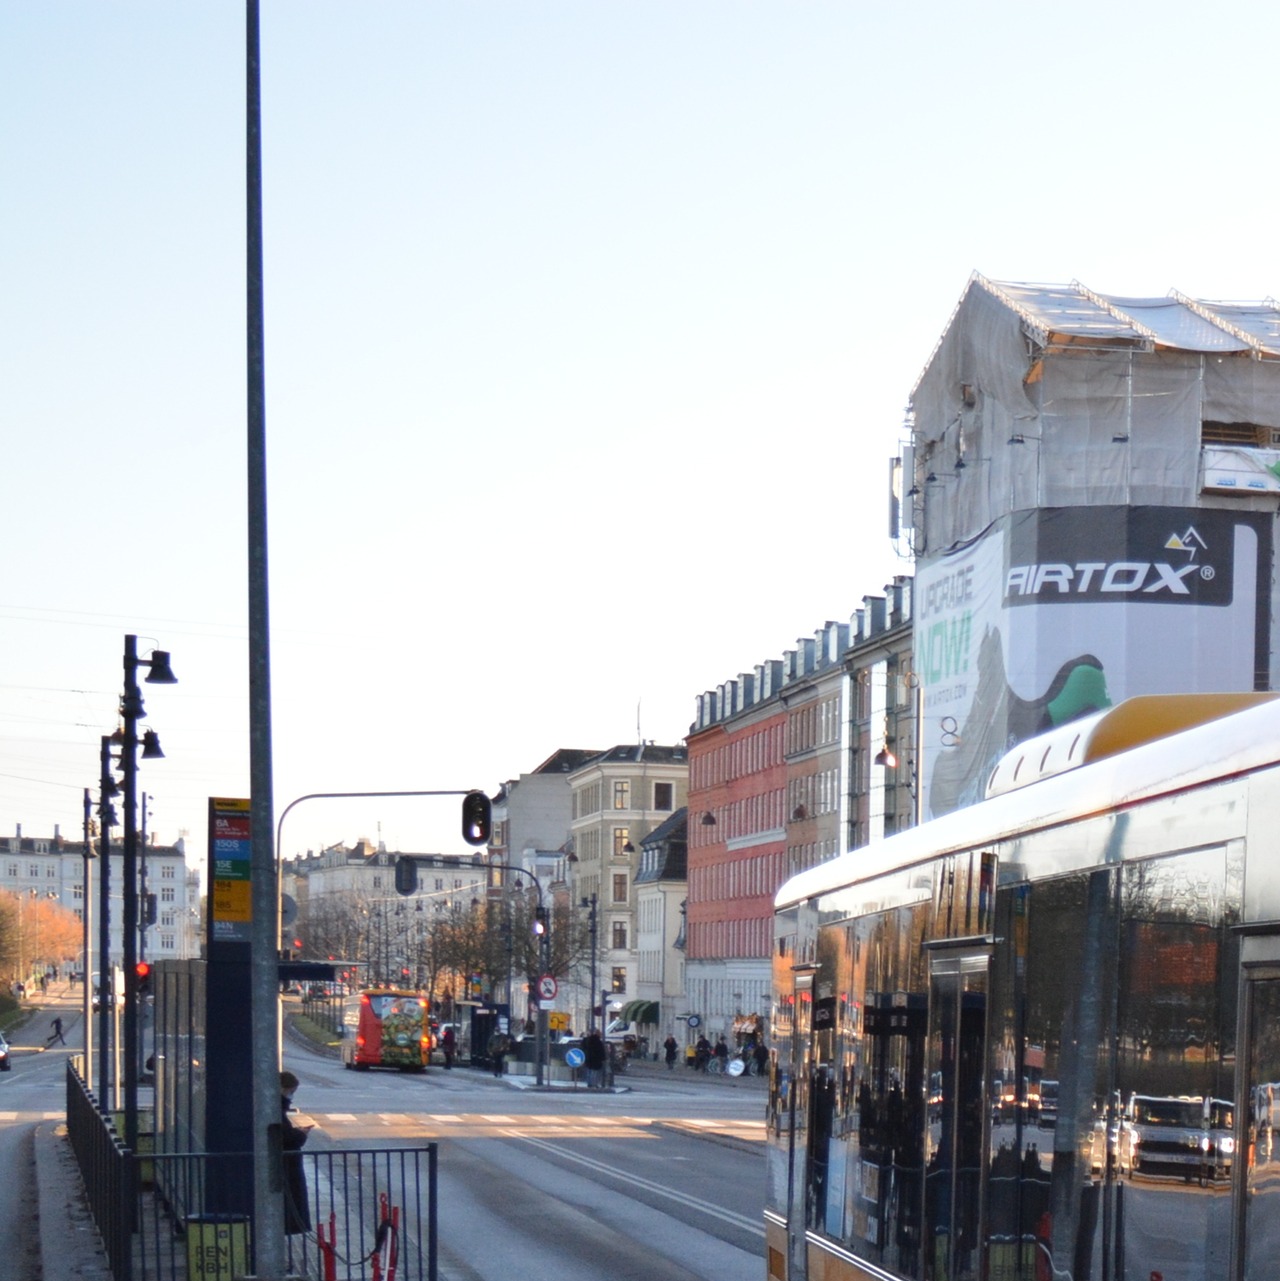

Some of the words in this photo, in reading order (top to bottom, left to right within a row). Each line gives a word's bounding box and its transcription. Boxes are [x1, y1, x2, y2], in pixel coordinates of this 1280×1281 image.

[1004, 562, 1200, 598] AIRTOX
[919, 564, 975, 621] UPGRADE
[215, 818, 229, 827] 6A
[215, 840, 240, 848] 150S
